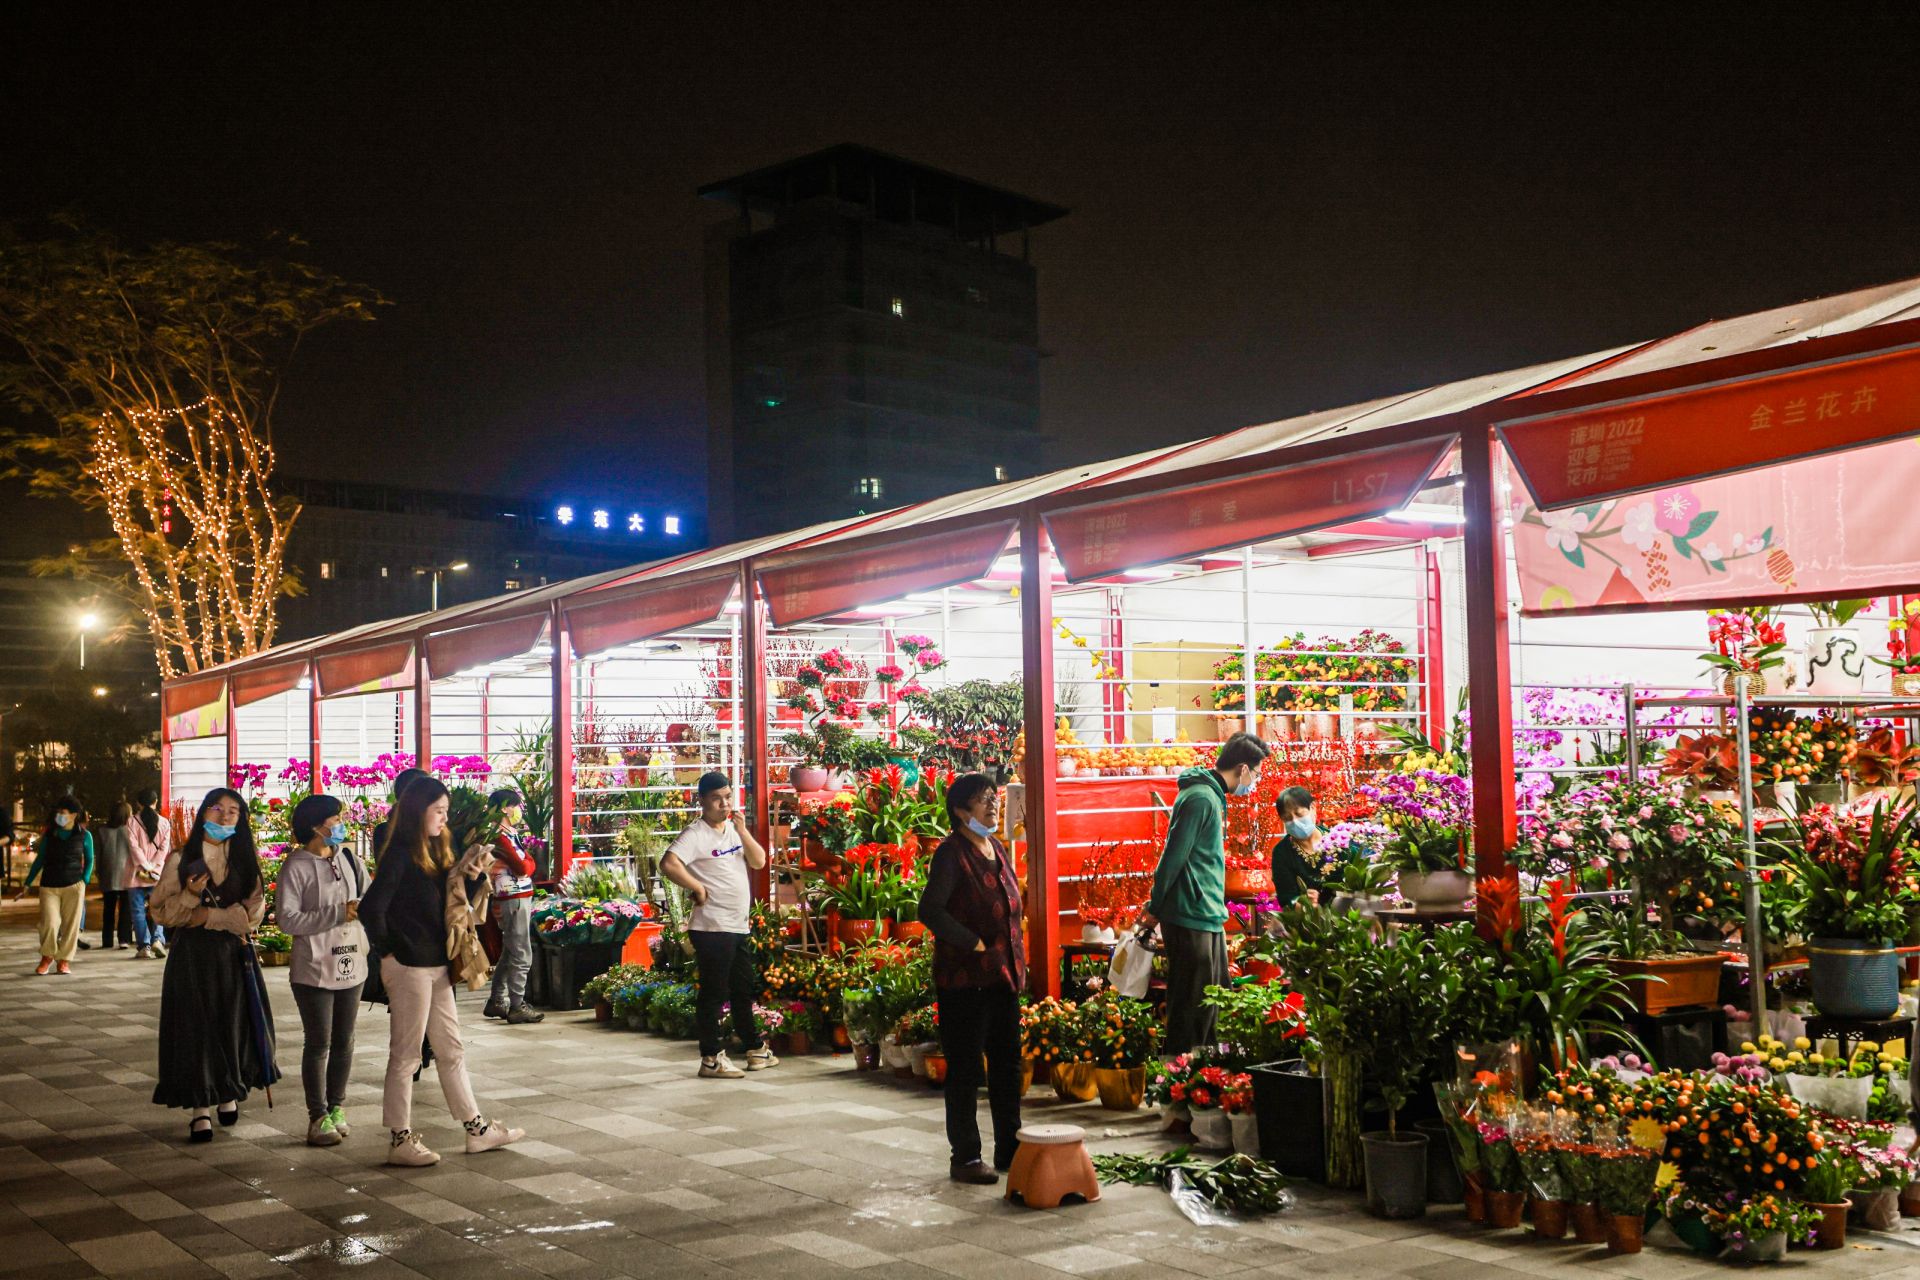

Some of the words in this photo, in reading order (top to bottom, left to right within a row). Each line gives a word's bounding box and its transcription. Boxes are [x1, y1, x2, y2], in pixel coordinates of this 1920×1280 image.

[1750, 386, 1877, 431] 金兰花卉
[1607, 417, 1645, 439] 2022
[1332, 472, 1388, 504] L1-S7
[1566, 467, 1597, 487] 花市
